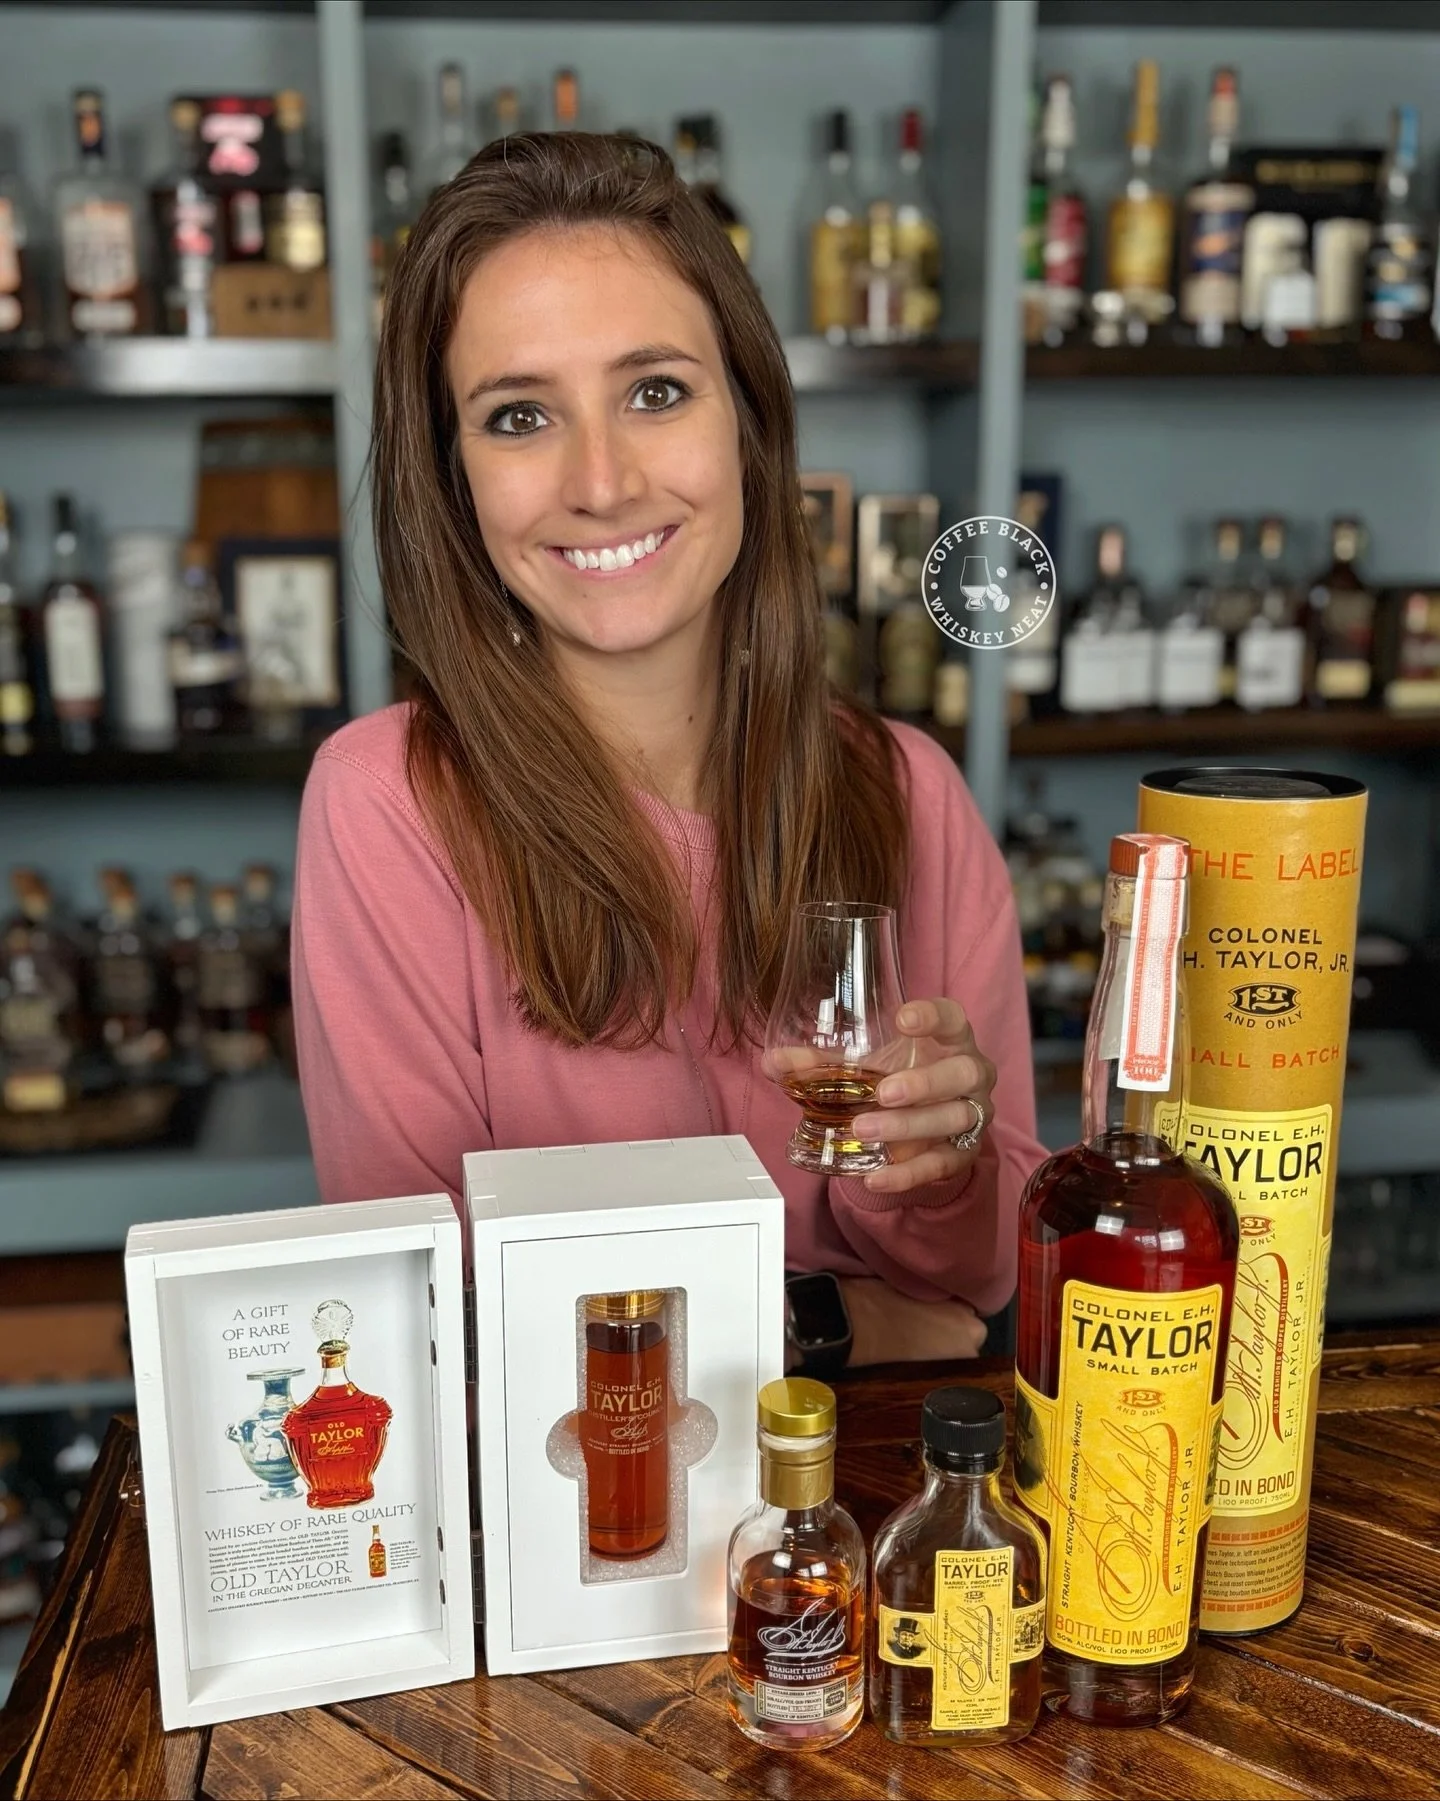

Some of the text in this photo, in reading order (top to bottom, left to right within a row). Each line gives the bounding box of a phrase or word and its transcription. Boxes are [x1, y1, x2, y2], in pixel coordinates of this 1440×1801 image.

[1277, 848, 1359, 881] LABEL
[1208, 927, 1323, 945] COLONEL
[1216, 950, 1323, 973] TAYLOR,
[1330, 954, 1349, 973] JR.
[1223, 1010, 1304, 1030] AND ONLY
[1190, 1047, 1340, 1069] ALL BATCH
[1190, 1124, 1284, 1142] OLONEL
[1293, 1124, 1325, 1139] E.H.
[1259, 1186, 1308, 1201] BATCH
[1250, 1232, 1277, 1247] ONLY
[1073, 1299, 1214, 1322] COLONEL E.H.
[1279, 1279, 1288, 1321] DISTILLERY
[232, 1304, 288, 1321] A GIFT
[222, 1323, 290, 1342] OF RARE
[1072, 1314, 1212, 1359] TAYLOR
[1277, 1323, 1286, 1353] COPPER
[1287, 1317, 1301, 1389] TAYLOR
[1295, 1273, 1305, 1304] JR.
[228, 1341, 290, 1360] BEAUTY
[1087, 1359, 1198, 1376] SMALL BATCH
[1274, 1355, 1283, 1398] FASHIONED
[590, 1380, 643, 1393] COLONEL
[590, 1384, 663, 1413] TAYLOR
[1116, 1404, 1167, 1417] AND ONLY
[310, 1426, 365, 1444] TAYLOR
[327, 1421, 346, 1429] OLD
[1177, 1480, 1190, 1547] TAYLOR
[1184, 1439, 1195, 1469] JR.
[1235, 1479, 1252, 1496] IN
[1257, 1470, 1295, 1495] BOND
[1061, 1401, 1084, 1609] STRAIGHT KENTUCKY BOURBON WHISKEY
[204, 1503, 417, 1542] WHISKEY OF RARE QUALITY
[210, 1572, 257, 1593] OLD
[264, 1559, 353, 1585] TAYLOR
[941, 1561, 1009, 1579] TAYLOR
[212, 1575, 353, 1603] IN THE GRECIAN DECANTER
[1055, 1614, 1184, 1646] BOTTLED IN BOND
[765, 1659, 840, 1675] STRAIGHT KENTUCKY
[768, 1668, 837, 1681] BOURBON WHISKEY
